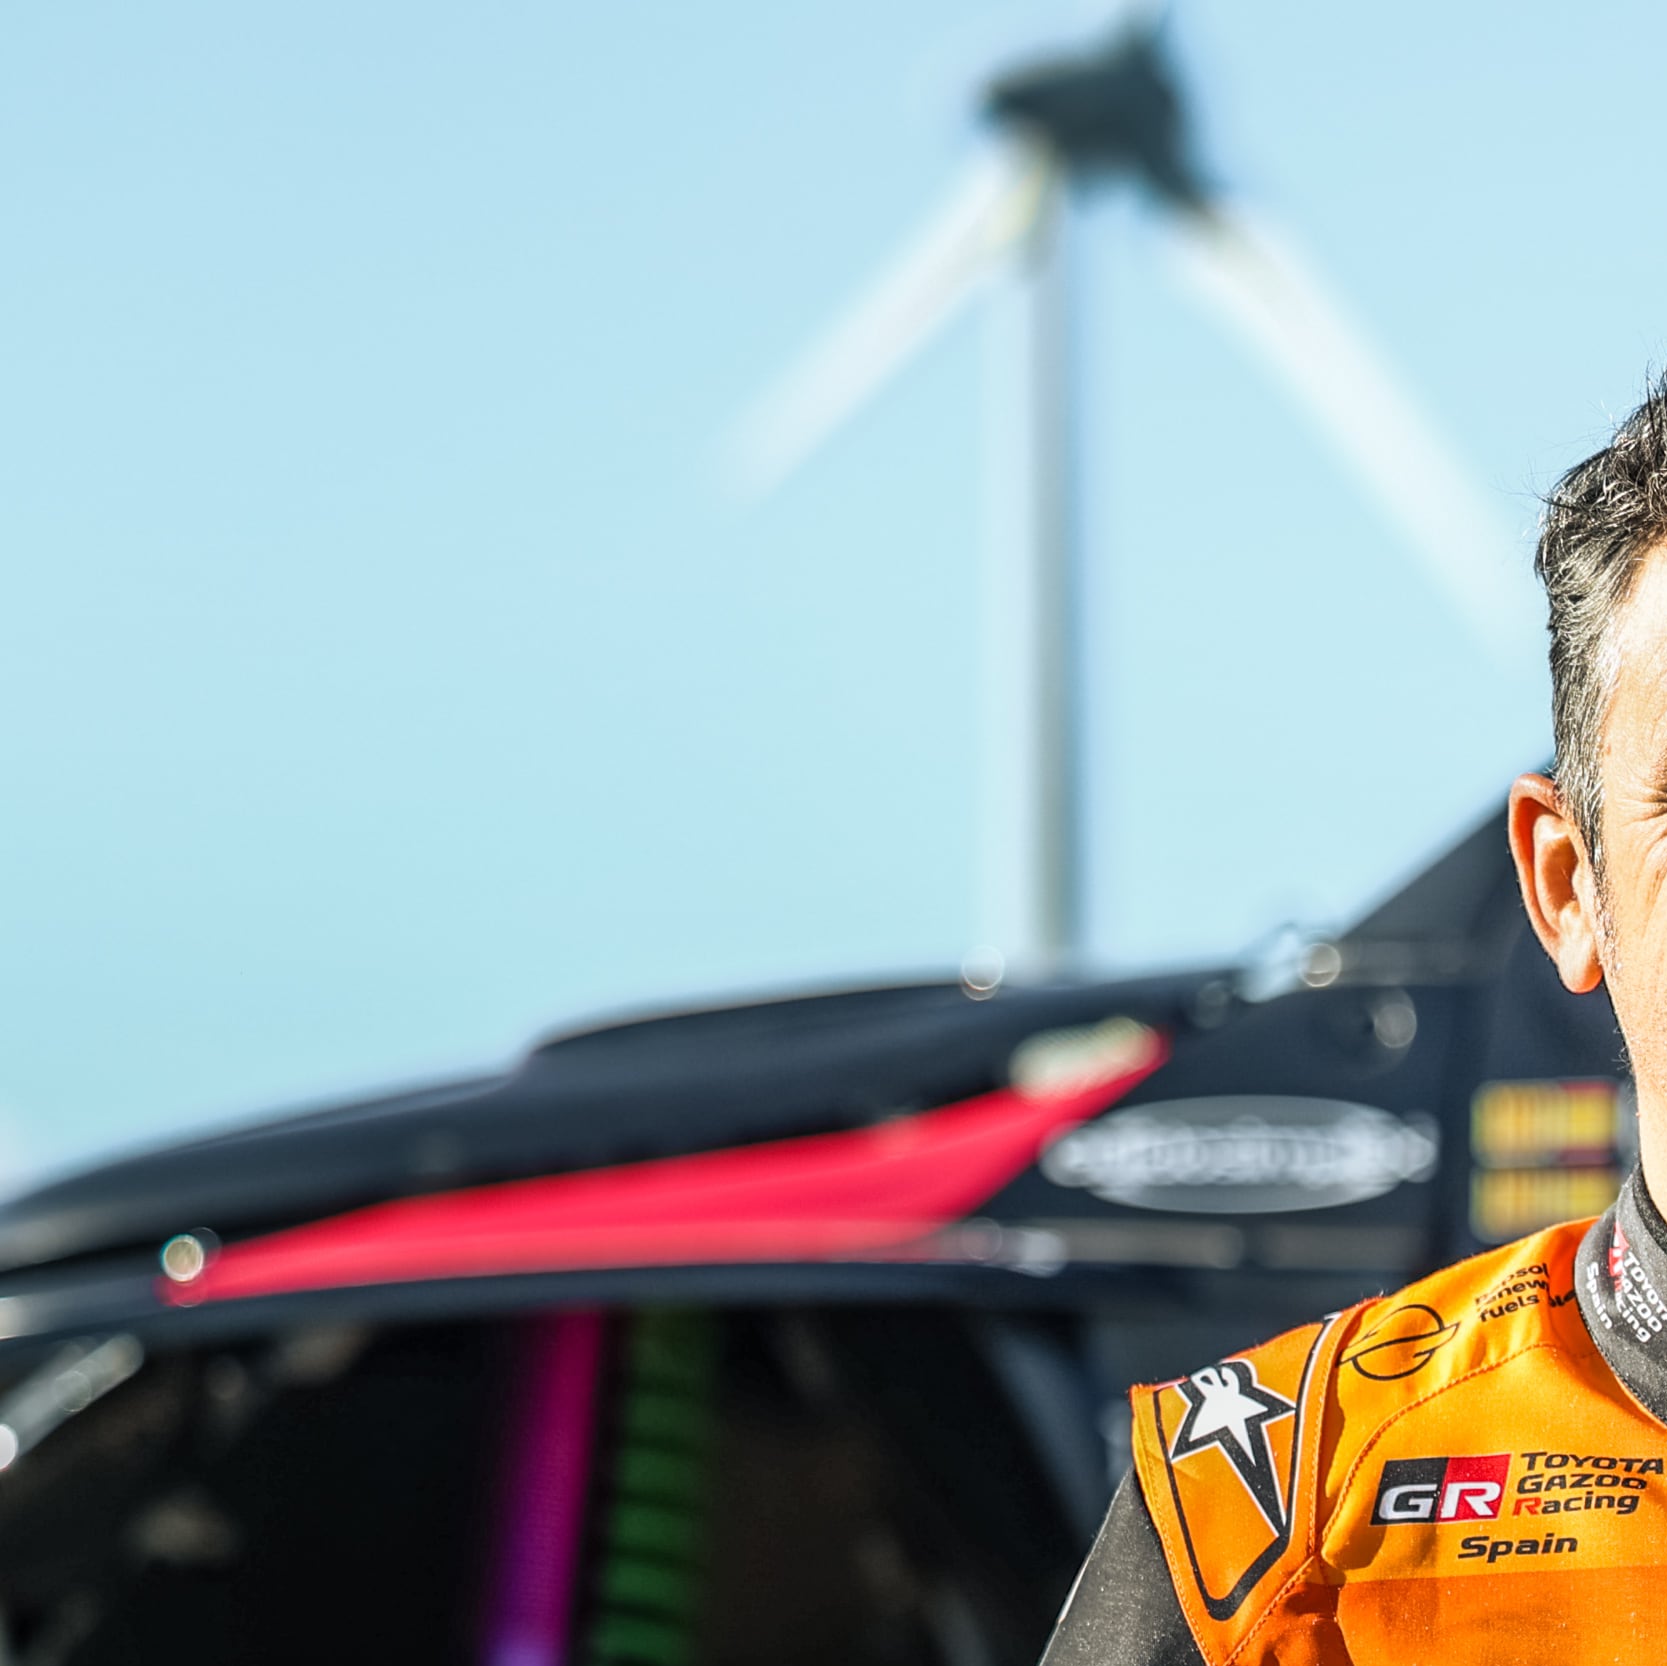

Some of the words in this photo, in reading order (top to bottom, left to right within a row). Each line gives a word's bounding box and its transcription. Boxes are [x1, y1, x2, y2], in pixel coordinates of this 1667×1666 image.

[1519, 1452, 1665, 1475] TOYOTA
[1377, 1481, 1501, 1520] GR
[1516, 1473, 1648, 1495] GAZOO
[1511, 1490, 1640, 1516] Racing
[1457, 1533, 1578, 1563] Spain
